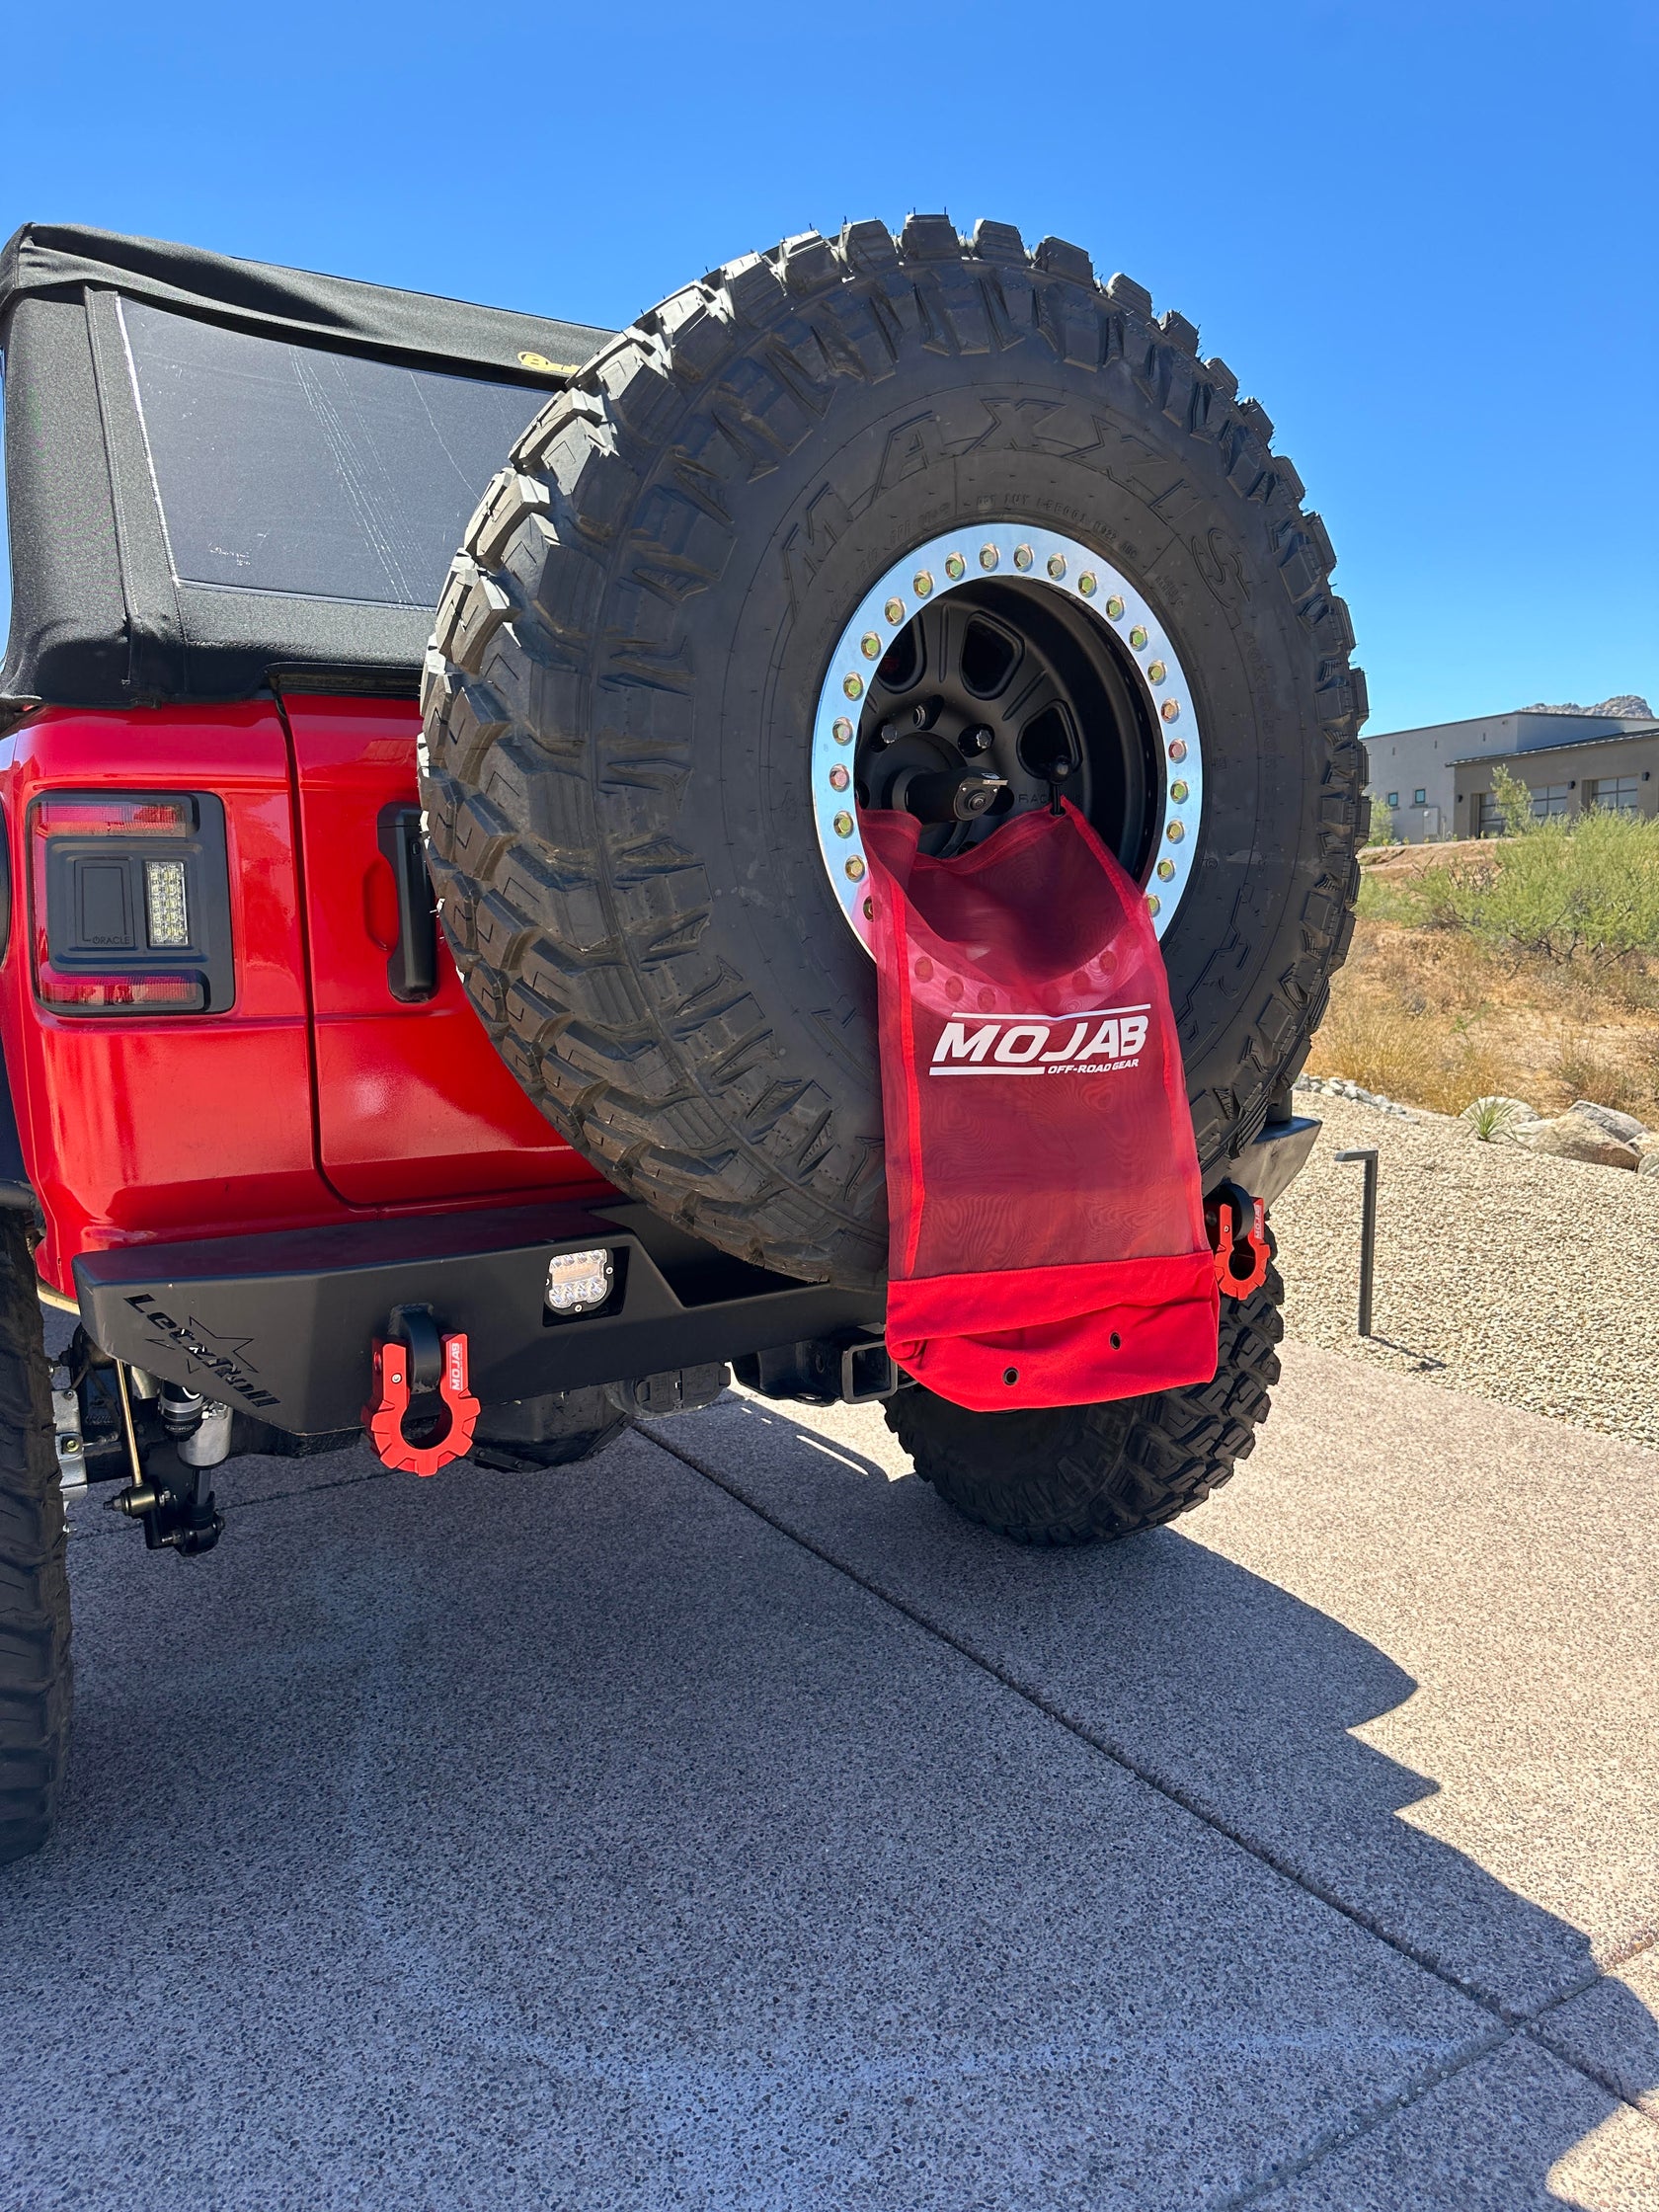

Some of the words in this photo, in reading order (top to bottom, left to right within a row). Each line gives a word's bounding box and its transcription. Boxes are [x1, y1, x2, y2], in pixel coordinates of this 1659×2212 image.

[783, 397, 1252, 623] MAXXIS
[92, 935, 131, 945] ORACLE
[932, 1015, 1148, 1064] MOJAB
[1048, 1065, 1112, 1075] OFF-ROAD
[1111, 1059, 1140, 1071] GEAR
[451, 1342, 461, 1390] MOJAB
